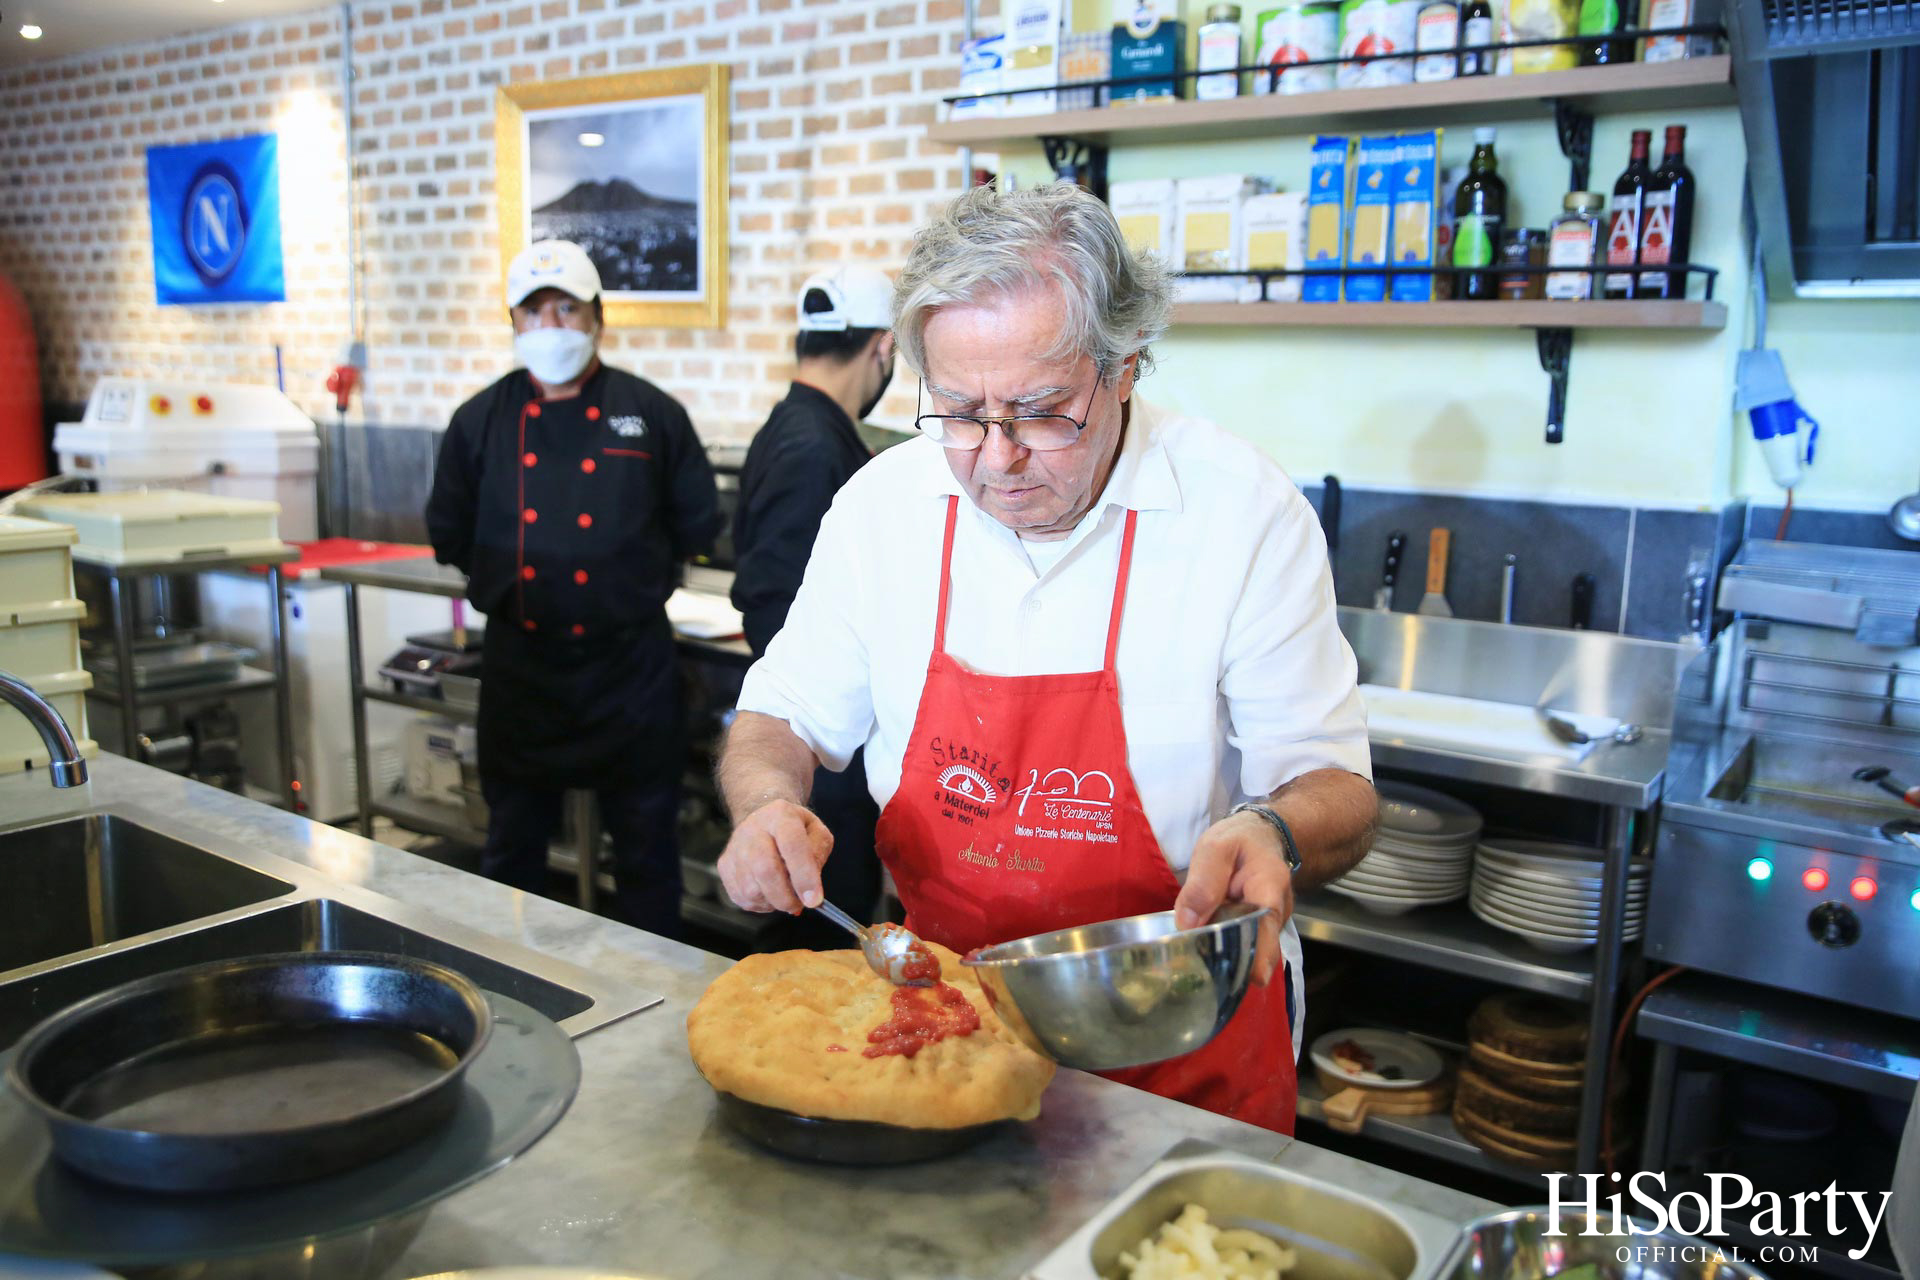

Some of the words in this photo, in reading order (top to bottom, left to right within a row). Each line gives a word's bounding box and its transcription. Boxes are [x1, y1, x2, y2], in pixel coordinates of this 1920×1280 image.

[200, 194, 231, 256] N
[930, 737, 1011, 792] Starita
[958, 814, 974, 827] 1901
[1014, 824, 1034, 837] Unione
[1035, 826, 1058, 839] Pizzerie
[1060, 828, 1084, 841] Storiche
[1086, 830, 1118, 844] Napoletane
[958, 841, 999, 868] Antonio
